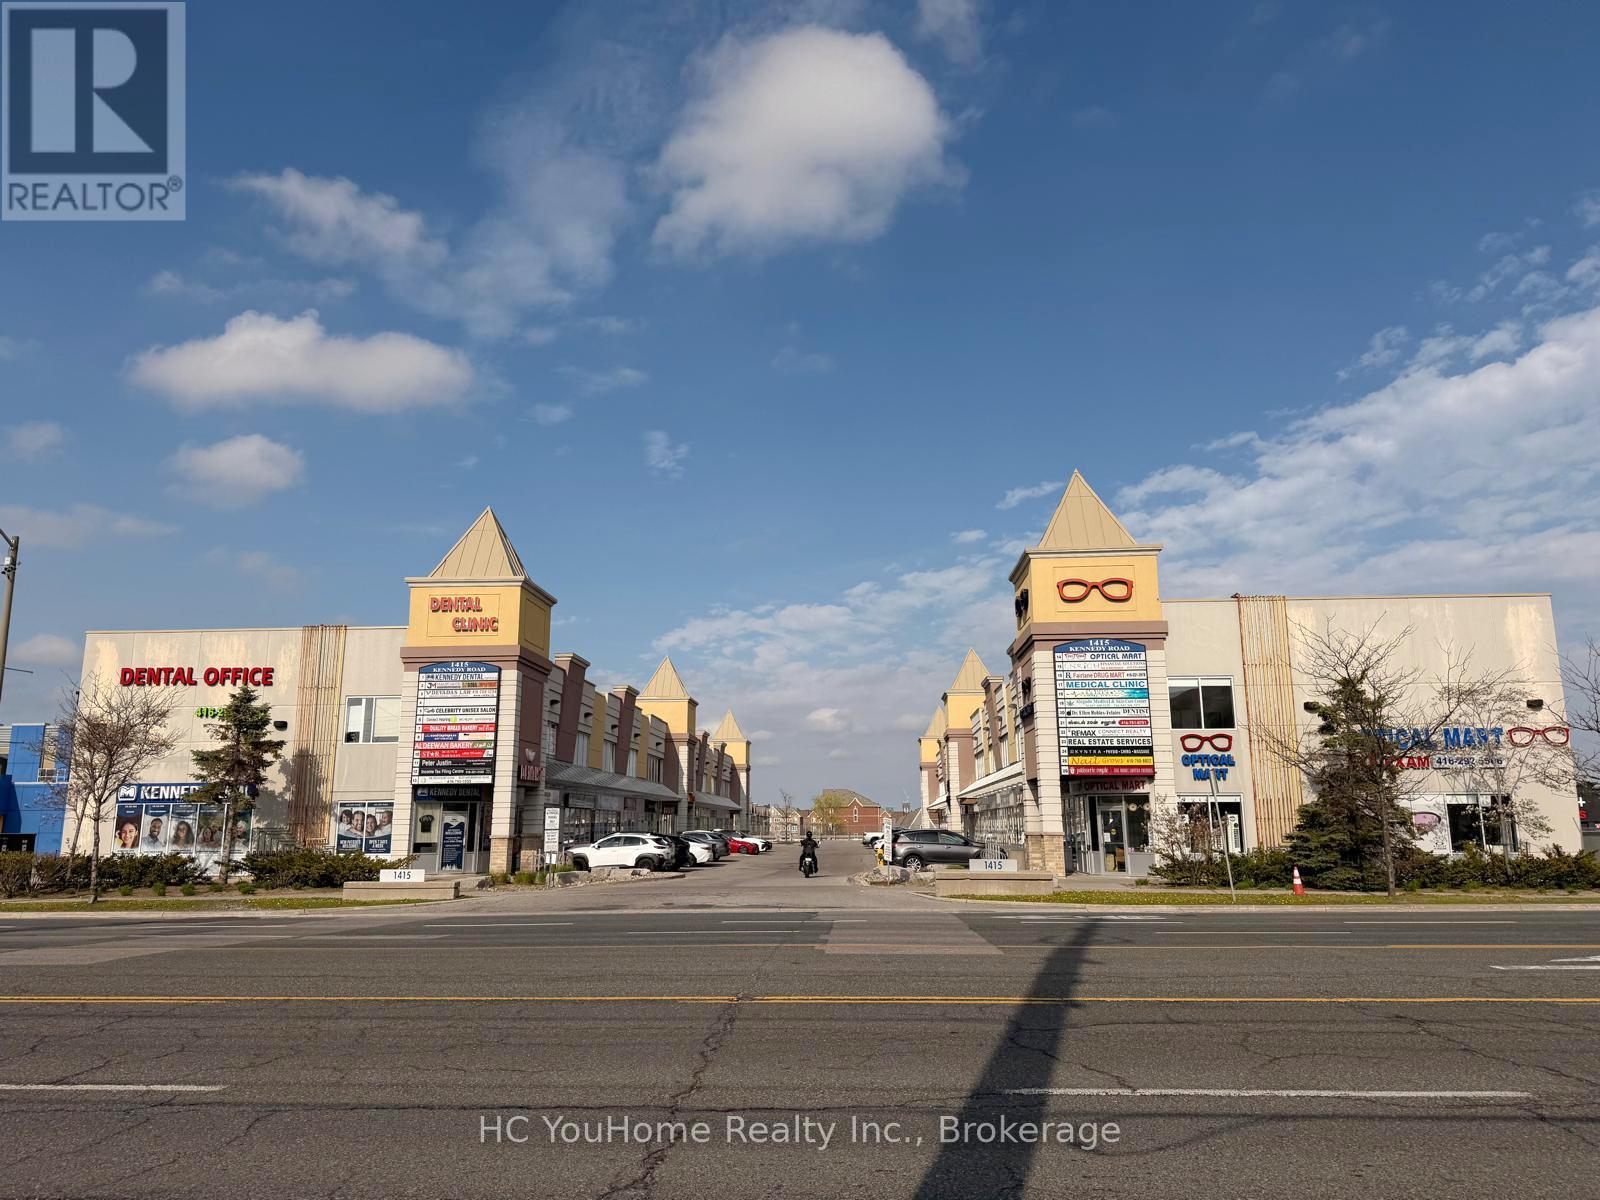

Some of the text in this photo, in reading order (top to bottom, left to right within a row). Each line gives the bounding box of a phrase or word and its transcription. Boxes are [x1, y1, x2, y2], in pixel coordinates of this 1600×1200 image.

[430, 597, 482, 612] DENTAL
[452, 617, 499, 632] CLINIC
[119, 667, 274, 687] DENTAL OFFICE
[449, 741, 473, 749] BAKERY
[1181, 754, 1236, 768] OPTICAL
[1084, 780, 1145, 791] OPTICAL MART
[429, 787, 480, 796] KENNEDY DENTAL
[984, 861, 1002, 870] 1415
[394, 871, 411, 880] 1415
